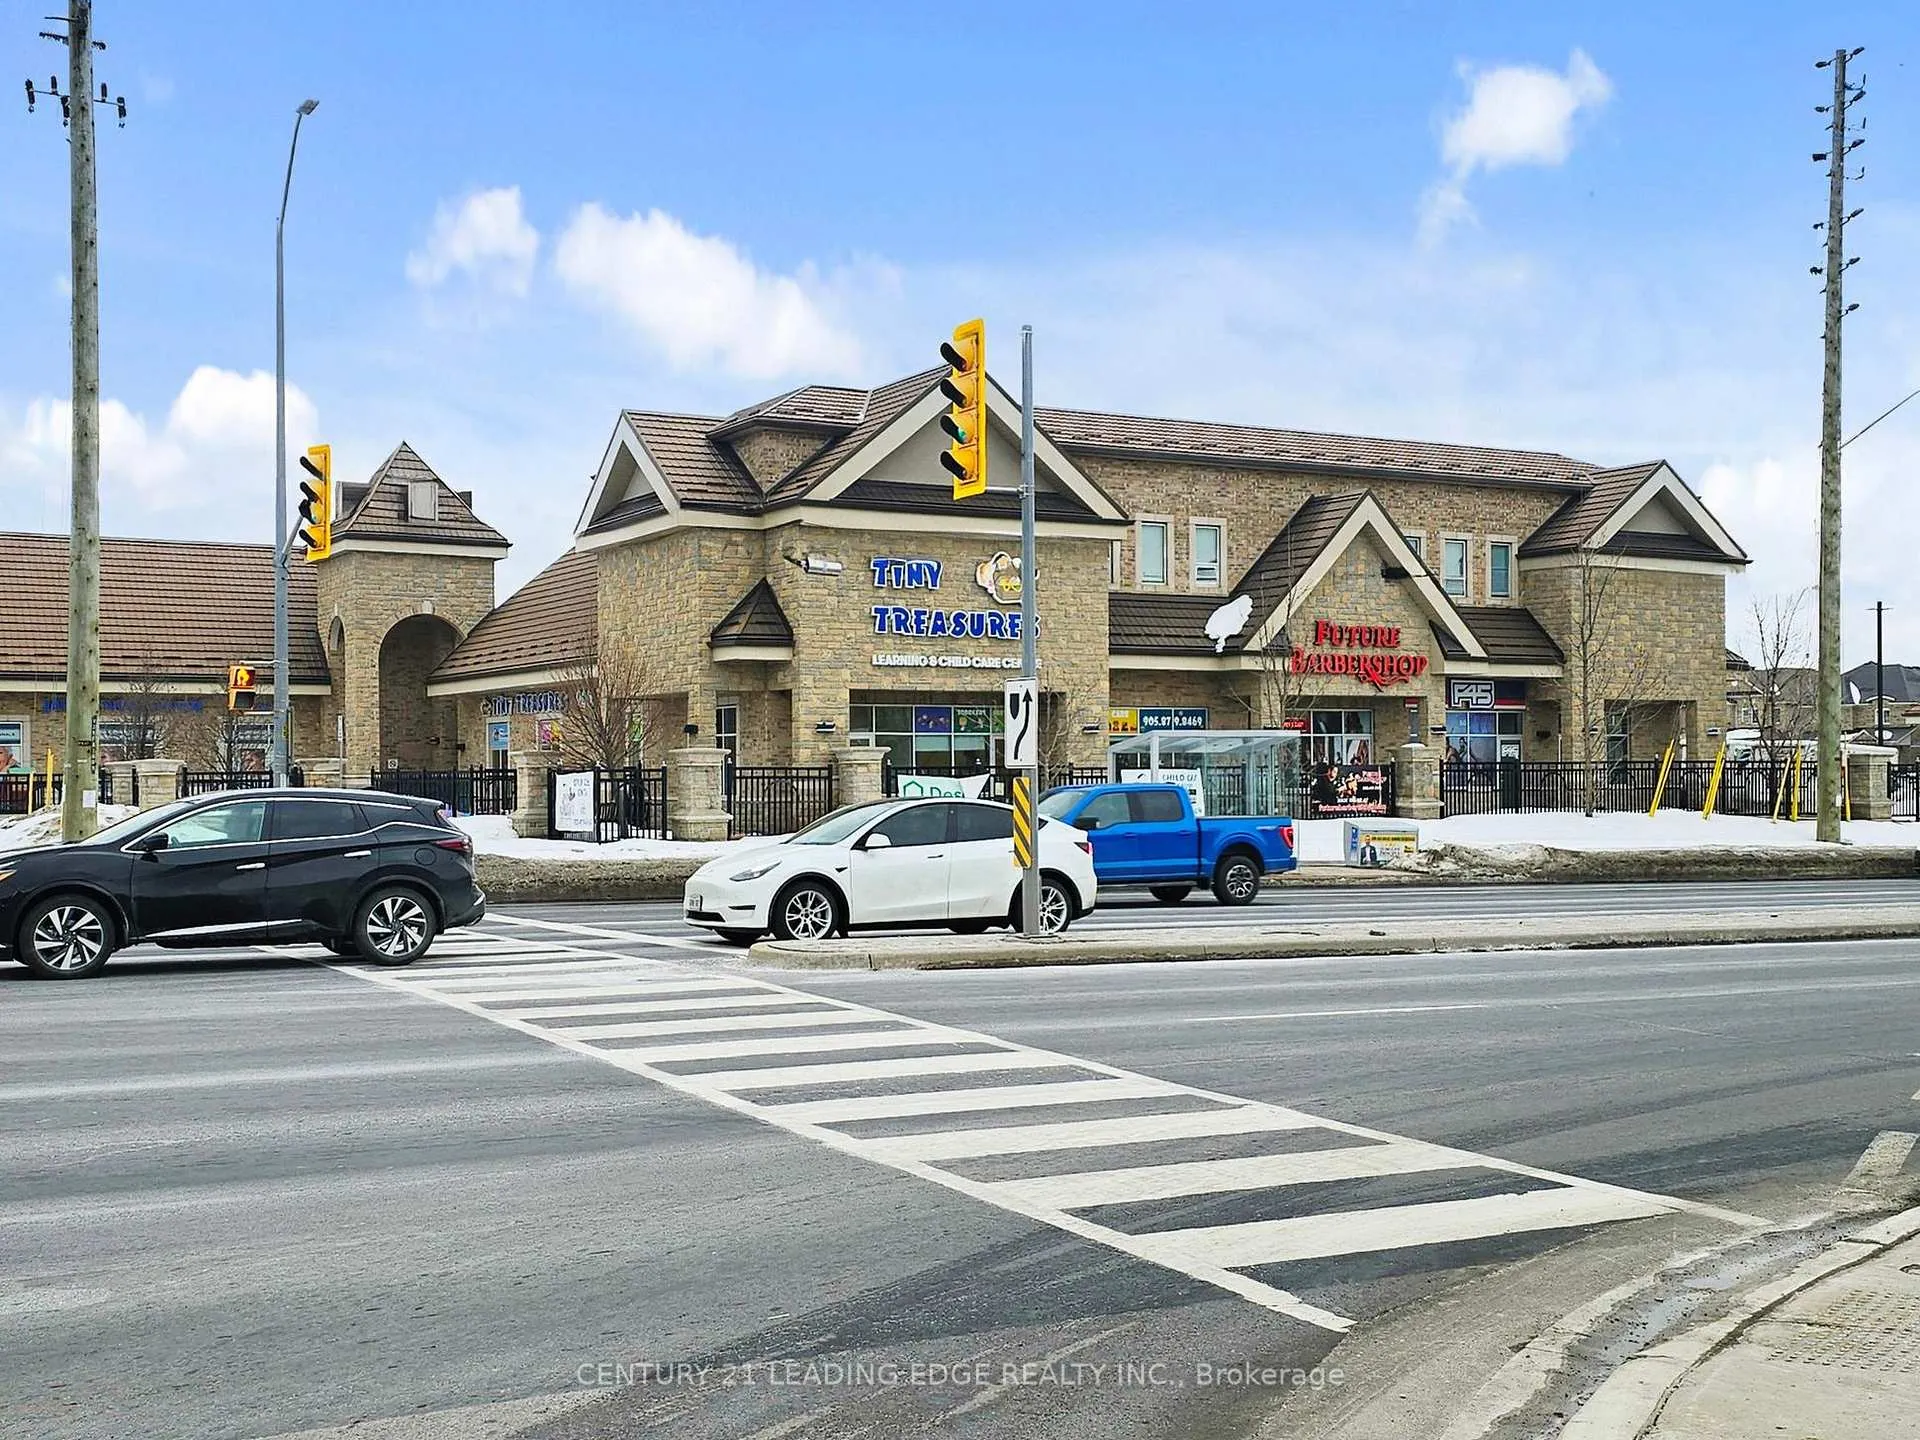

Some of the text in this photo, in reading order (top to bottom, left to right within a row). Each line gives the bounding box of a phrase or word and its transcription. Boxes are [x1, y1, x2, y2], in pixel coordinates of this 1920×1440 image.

[872, 654, 928, 667] LEARNING
[938, 656, 971, 668] CHILD
[972, 657, 1001, 669] CARE
[1002, 658, 1042, 670] CENE
[1451, 681, 1494, 707] F45
